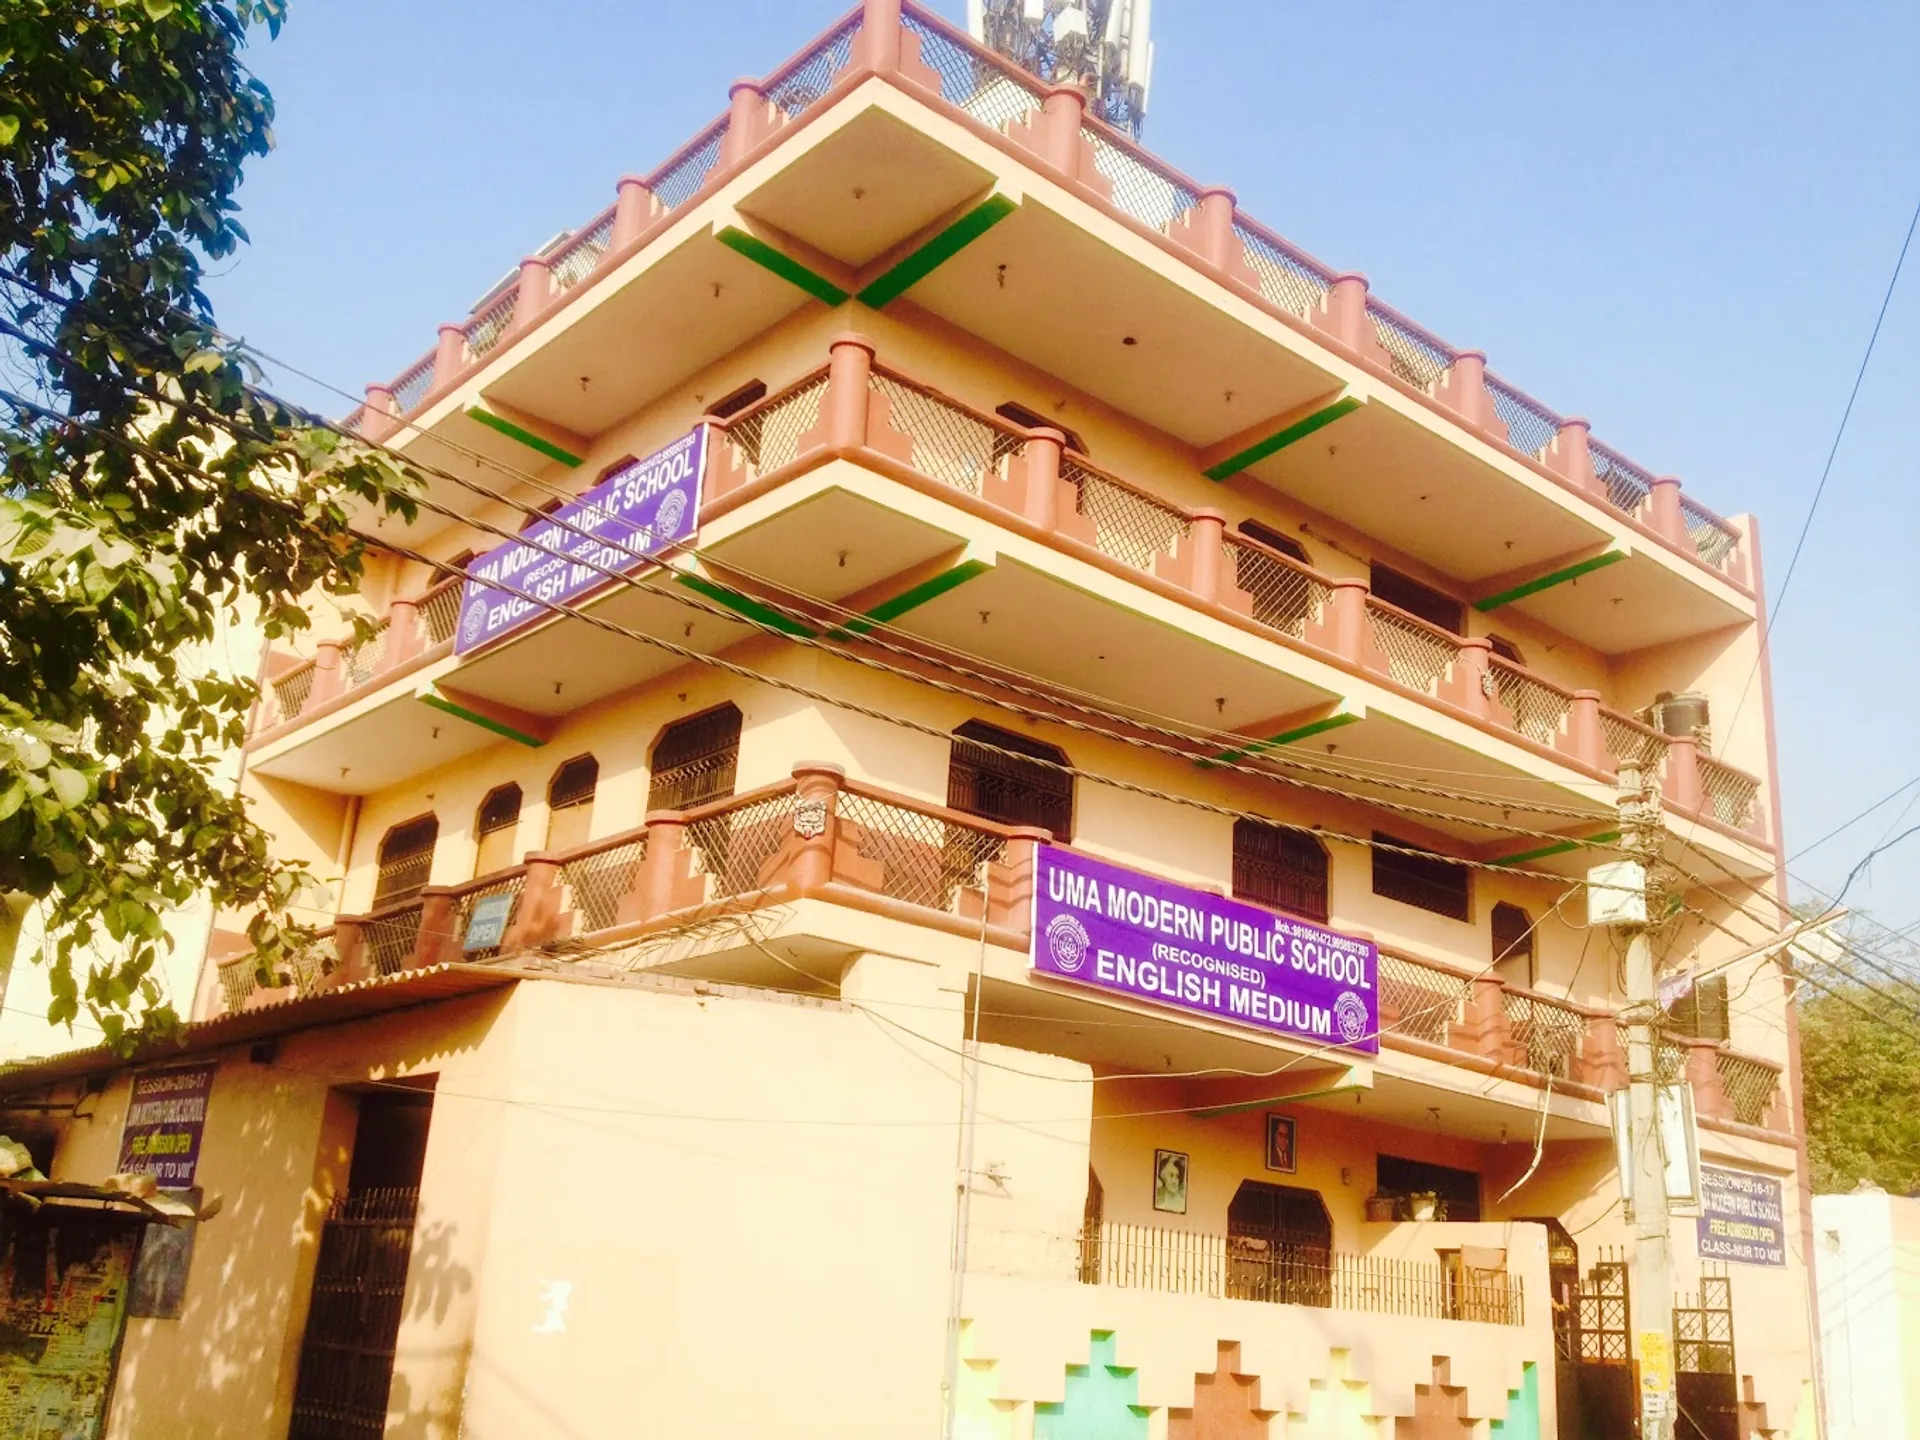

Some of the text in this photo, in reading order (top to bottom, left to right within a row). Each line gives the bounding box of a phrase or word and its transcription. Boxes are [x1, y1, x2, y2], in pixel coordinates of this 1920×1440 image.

[469, 561, 499, 597] UMA
[624, 449, 694, 510] SCHOOL
[1049, 867, 1371, 989] UMA MODERN PUBLIC SCHOOL
[1152, 942, 1266, 989] (RECOGNISED)
[1097, 950, 1221, 1008] ENGLISH
[1229, 984, 1331, 1036] MEDIUM
[1753, 1246, 1766, 1260] TO
